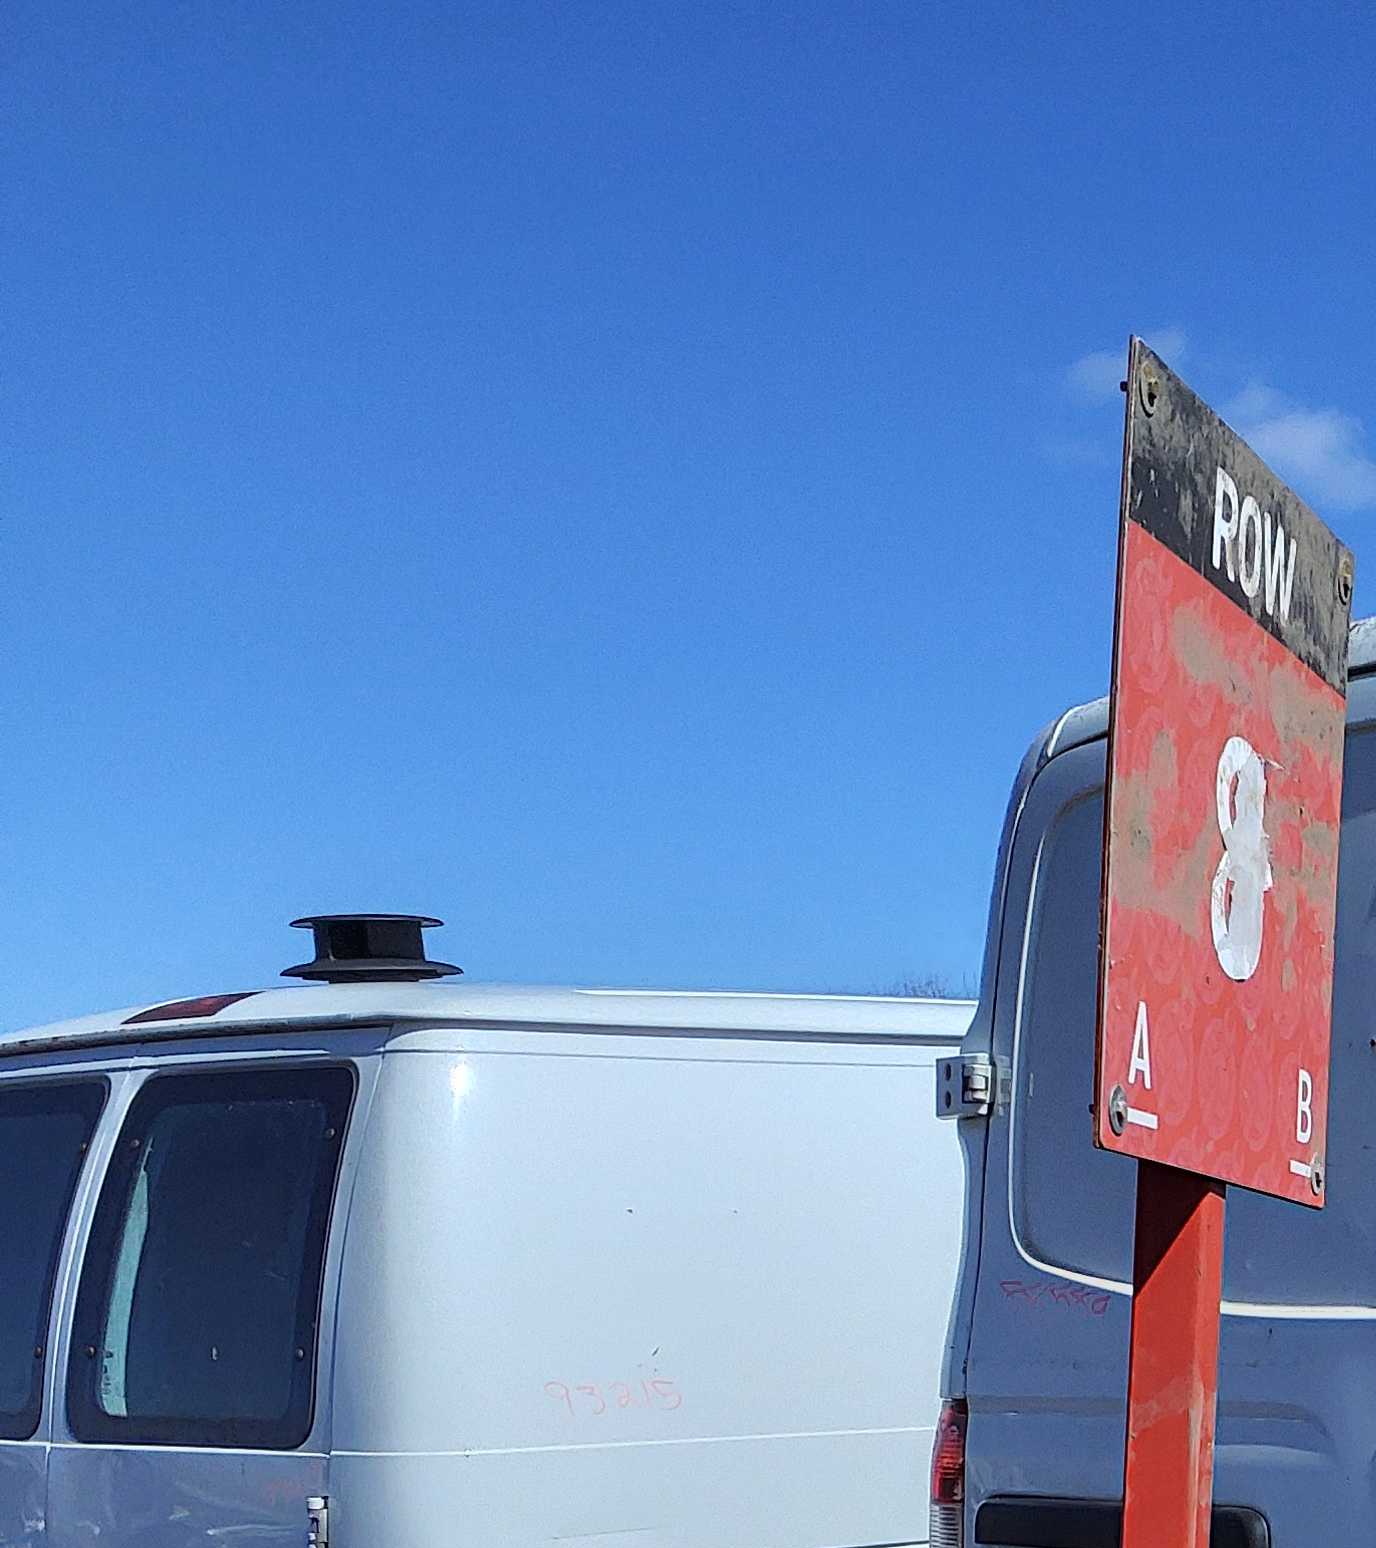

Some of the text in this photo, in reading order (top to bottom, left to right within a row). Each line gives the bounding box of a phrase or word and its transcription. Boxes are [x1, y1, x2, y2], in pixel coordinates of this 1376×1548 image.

[1211, 465, 1298, 625] ROW
[1210, 735, 1273, 982] 8
[1126, 1001, 1153, 1092] A
[1294, 1068, 1313, 1145] B
